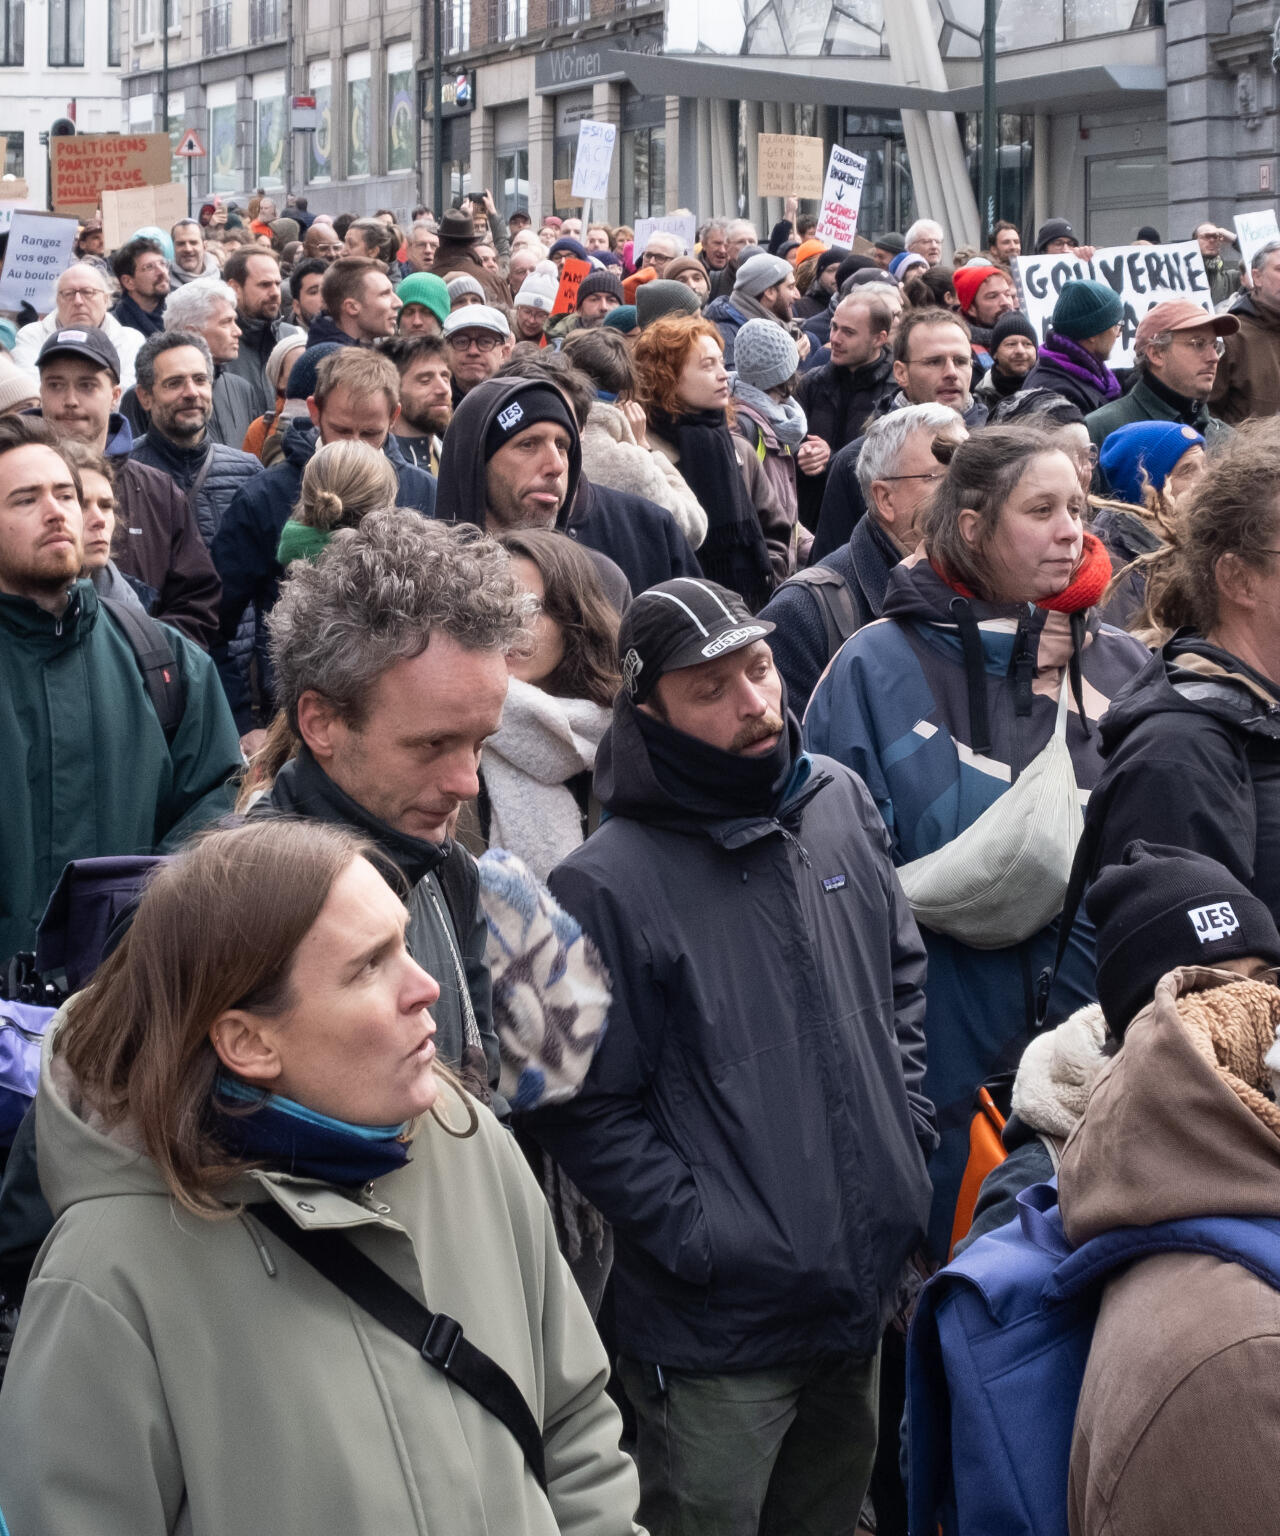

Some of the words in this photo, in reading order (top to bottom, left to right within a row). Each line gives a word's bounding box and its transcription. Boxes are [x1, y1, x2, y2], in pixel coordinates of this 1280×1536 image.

[57, 138, 148, 155] POLITICIENS
[57, 156, 127, 171] PARTOUT
[57, 169, 142, 185] POLITIQUE
[57, 184, 97, 198] NULLE
[22, 235, 62, 248] Rangez
[16, 253, 35, 262] vos
[7, 269, 22, 279] Au
[1025, 251, 1210, 300] GOUVERNE
[501, 405, 521, 424] JES
[1197, 906, 1235, 932] JES
